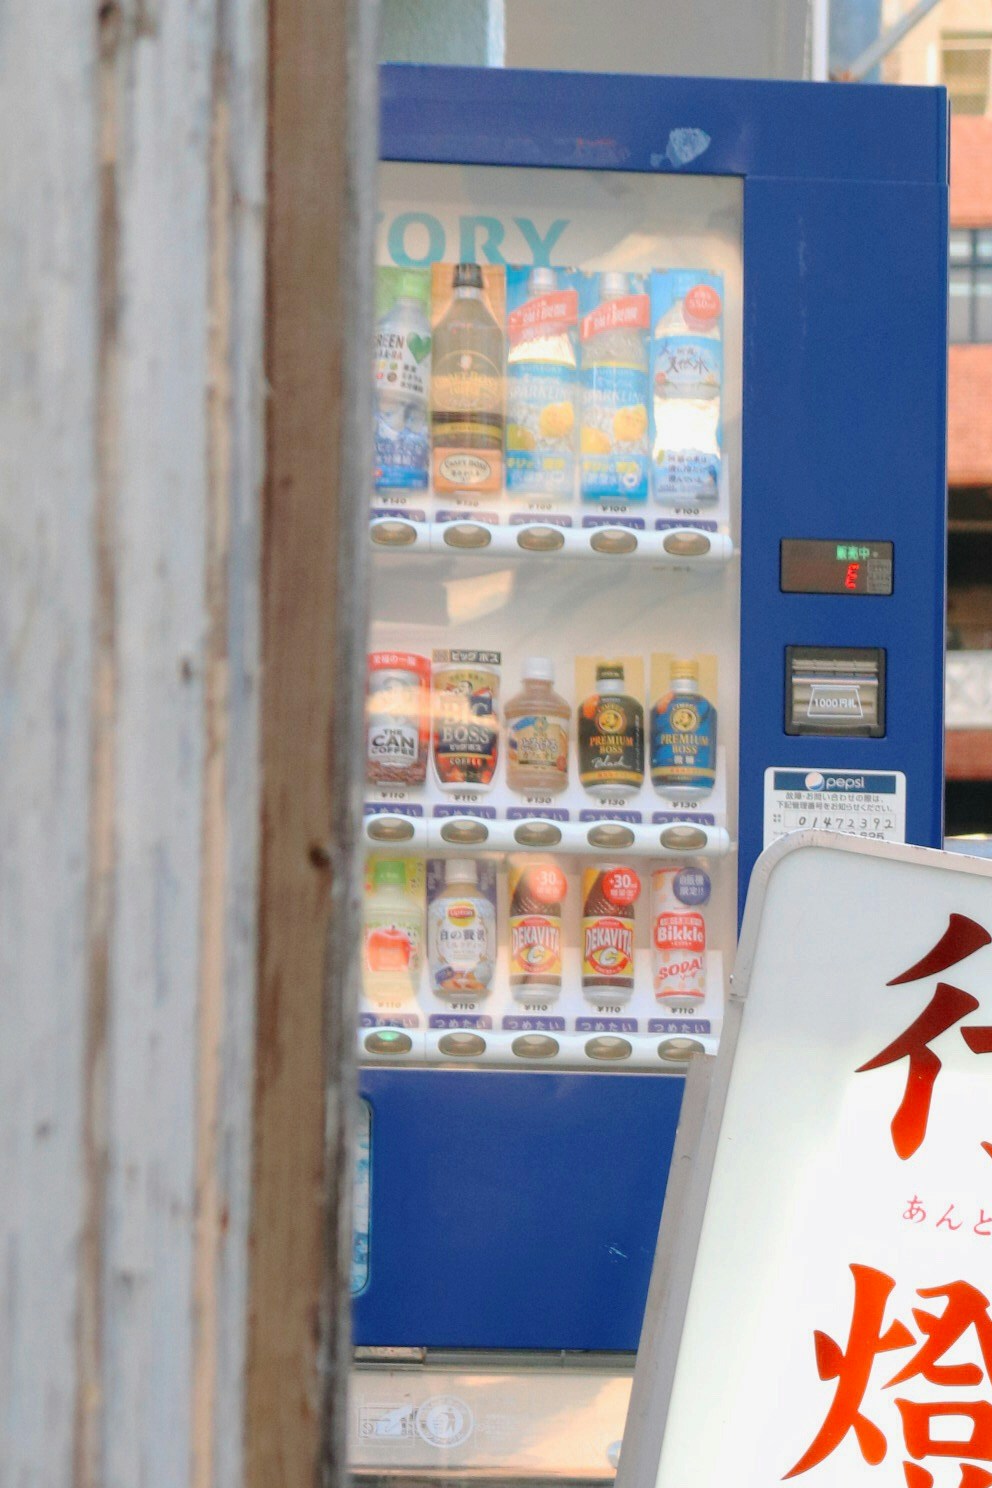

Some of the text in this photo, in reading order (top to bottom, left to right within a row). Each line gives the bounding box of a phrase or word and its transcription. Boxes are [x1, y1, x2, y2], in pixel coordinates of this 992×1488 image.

[374, 211, 570, 268] ORY
[674, 507, 700, 515] ¥100
[836, 545, 871, 560] 販売中
[814, 697, 858, 710] 1000円札
[442, 725, 490, 745] BOSS
[590, 734, 634, 746] PREMIUM
[661, 733, 709, 746] PREMIUM
[372, 735, 415, 749] CAN
[371, 747, 415, 757] COFFEE
[600, 745, 623, 754] BOSS
[672, 744, 697, 755] BOSS
[825, 776, 865, 790] pepsi
[454, 794, 478, 802] ¥110
[657, 926, 704, 942] Bikkle
[512, 925, 559, 958] DEKAVITA
[585, 927, 633, 960] DEKAVITA
[600, 946, 619, 966] C
[597, 1005, 621, 1013] ¥110
[671, 1006, 695, 1014] ¥110
[581, 1021, 632, 1031] つめたい
[654, 1022, 705, 1033] つめたい
